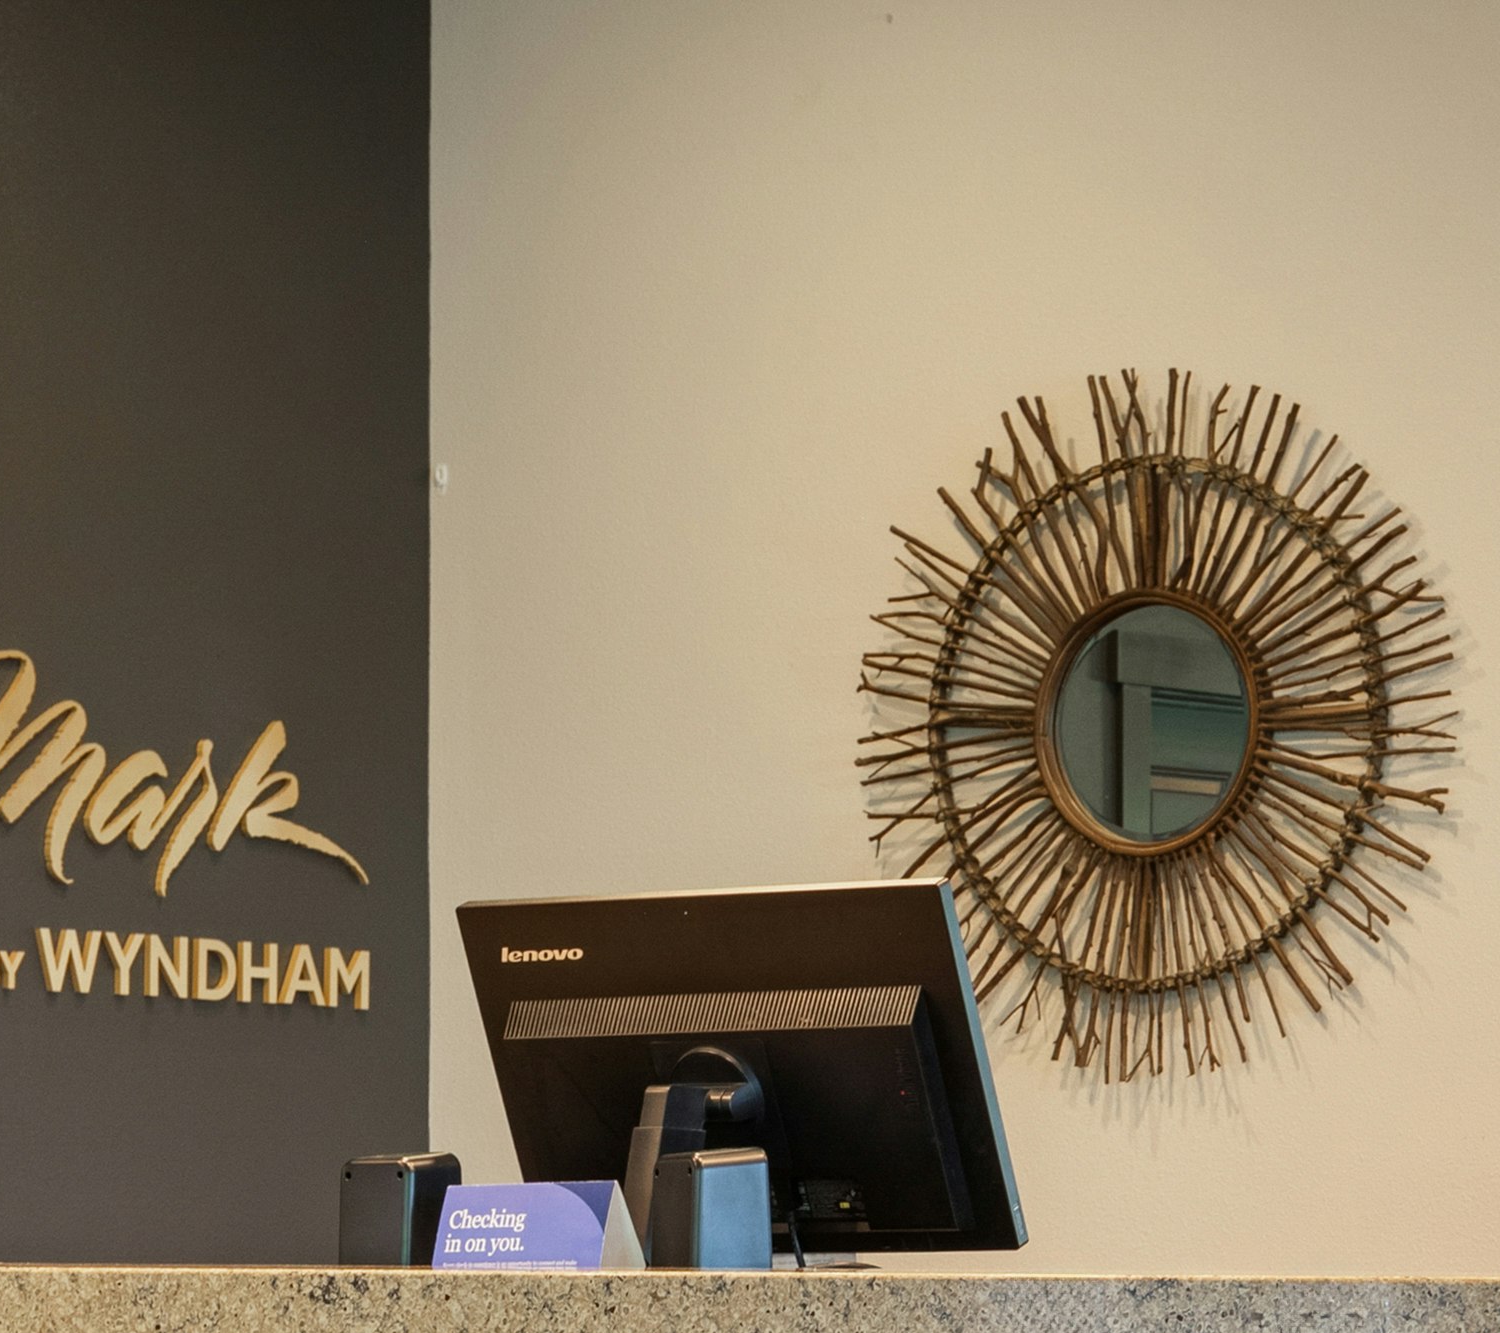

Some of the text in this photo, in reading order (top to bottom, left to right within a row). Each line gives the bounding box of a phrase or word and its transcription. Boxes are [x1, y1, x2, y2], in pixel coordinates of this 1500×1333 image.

[501, 946, 584, 963] lenovo
[35, 927, 371, 1011] WYNDHAM
[449, 1208, 527, 1232] Checking
[444, 1233, 525, 1257] in on you.
